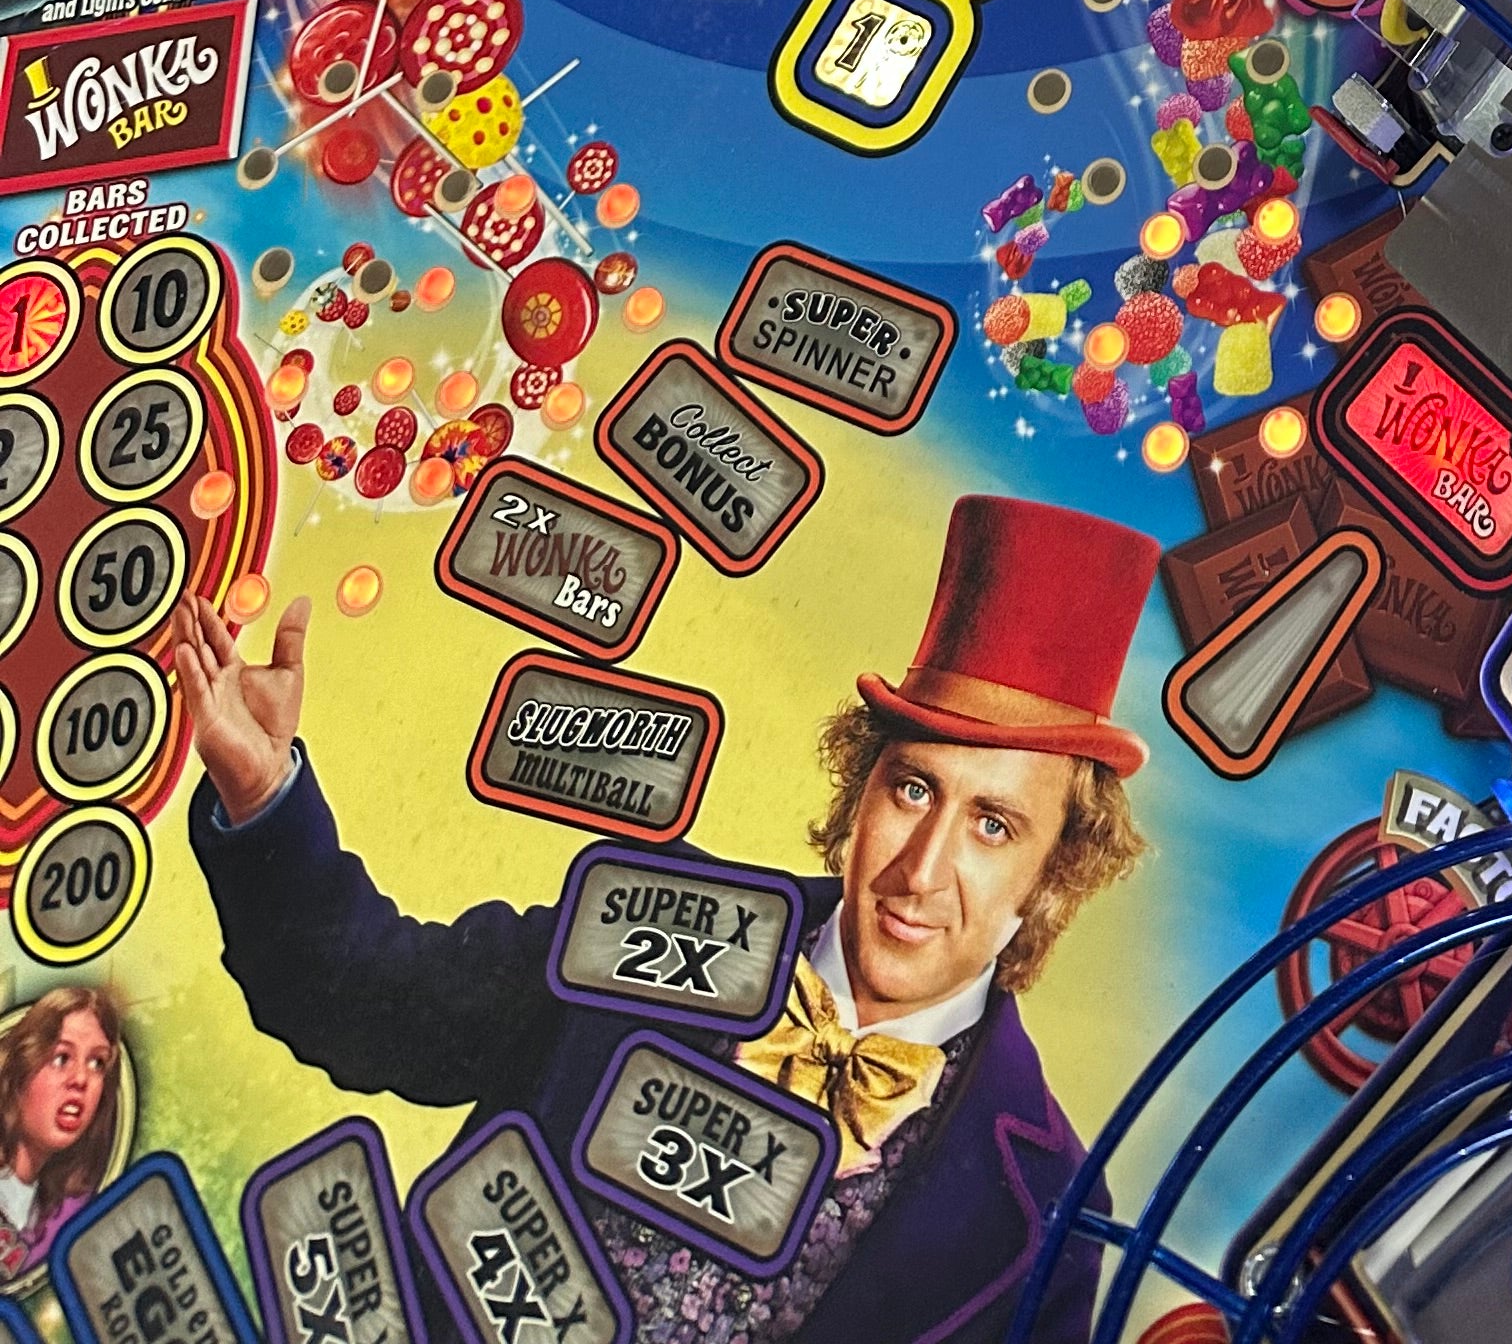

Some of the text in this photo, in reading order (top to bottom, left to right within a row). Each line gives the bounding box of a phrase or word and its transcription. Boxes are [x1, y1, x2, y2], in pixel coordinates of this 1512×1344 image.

[41, 0, 79, 24] and
[835, 13, 882, 71] 1
[24, 34, 221, 162] WONKA
[106, 98, 189, 153] BAR
[15, 204, 189, 256] COLLECTED
[65, 179, 149, 216] BARS
[9, 266, 189, 357] 1 10
[780, 288, 905, 361] SUPER
[751, 319, 898, 401] SPINNER
[108, 399, 172, 469] 25
[668, 401, 778, 485] Collect
[1374, 389, 1512, 496] WONKA
[633, 413, 756, 537] BONUS
[1432, 470, 1497, 540] BAR
[88, 544, 156, 615] 50
[489, 526, 628, 596] WONKA
[553, 573, 625, 629] Bars
[65, 696, 140, 758] 100
[508, 701, 693, 758] SLUGWORTH
[40, 849, 122, 914] 200
[600, 885, 761, 952] SUPER X
[612, 927, 730, 999] 2X
[632, 1077, 789, 1186] SUPER X
[637, 1126, 760, 1227] 3X
[318, 1179, 381, 1321] SUPER
[482, 1169, 588, 1344] SUPER X
[284, 1231, 350, 1344] 5X
[465, 1228, 552, 1344] 4X
